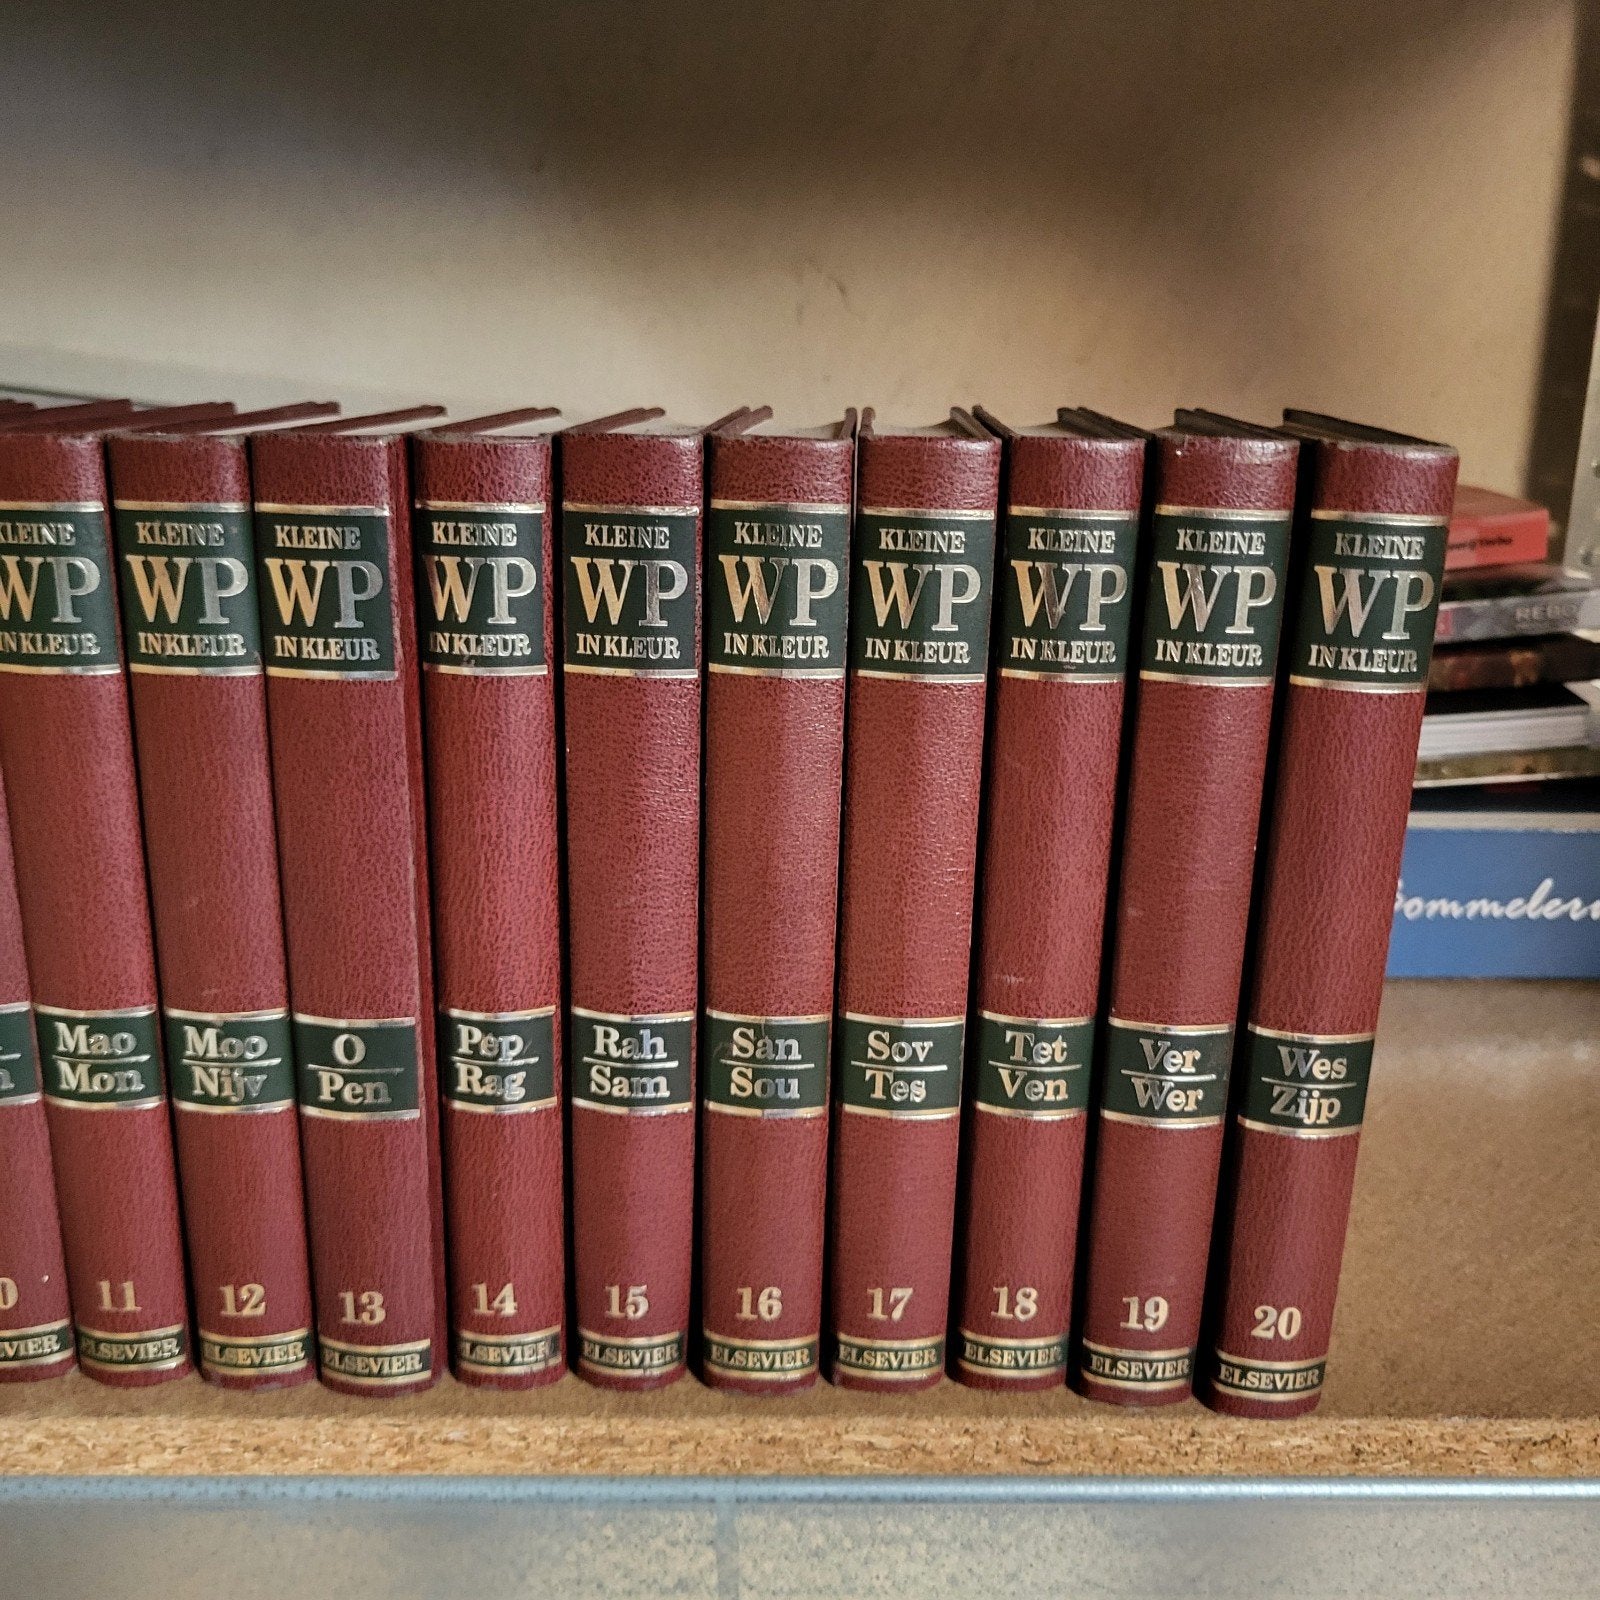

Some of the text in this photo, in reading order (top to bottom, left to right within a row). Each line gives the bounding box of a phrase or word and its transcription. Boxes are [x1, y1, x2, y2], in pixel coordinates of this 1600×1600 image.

[0, 521, 76, 545] LEINE
[136, 521, 226, 546] KLEINE
[274, 525, 361, 550] KLEINE
[432, 521, 518, 546] KLEINE
[584, 524, 670, 549] KLEINE
[734, 522, 823, 548] KLEINE
[879, 528, 965, 553] KLEINE
[1028, 527, 1116, 553] KLEINE
[1176, 528, 1266, 555] KLEINE
[1334, 533, 1426, 558] KLEINE
[0, 555, 100, 623] WP
[126, 555, 249, 624] WP
[264, 557, 384, 628] WP
[422, 556, 537, 624] WP
[571, 556, 689, 627] WP
[718, 555, 839, 626] WP
[863, 560, 981, 631] WP
[1010, 560, 1127, 631] WP
[1157, 560, 1277, 634] WP
[1313, 566, 1435, 640] WP
[0, 632, 101, 655] N KLEUR
[139, 632, 247, 656] IN KLEUR
[274, 635, 380, 660] IN KLEUR
[430, 632, 531, 656] IN KLEUR
[576, 633, 680, 659] IN KLEUR
[724, 632, 830, 659] IN KLEUR
[865, 637, 970, 663] IN KLEUR
[1011, 637, 1117, 663] IN KLEUR
[1155, 639, 1263, 666] IN KLEUR
[1309, 646, 1418, 672] IN KLEUR
[1395, 877, 1600, 921] ommeler
[55, 1022, 136, 1056] Mao
[184, 1025, 268, 1060] Moo
[332, 1033, 366, 1065] O
[457, 1024, 524, 1063] Pep
[593, 1025, 667, 1060] Rah
[731, 1027, 801, 1060] San
[868, 1030, 933, 1063] Sov
[1006, 1031, 1068, 1065] Tet
[1139, 1038, 1200, 1073] Ver
[57, 1061, 144, 1095] Mon
[1278, 1046, 1347, 1079] Wes
[192, 1066, 267, 1102] Nijv
[318, 1071, 390, 1105] Pen
[456, 1063, 525, 1102] Rag
[589, 1064, 670, 1098] Sam
[730, 1066, 800, 1099] Sou
[865, 1069, 926, 1102] Tes
[999, 1068, 1068, 1101] Ven
[1131, 1077, 1203, 1112] Wer
[1270, 1086, 1340, 1124] Zijp
[98, 1280, 142, 1312] 11
[220, 1284, 266, 1317] 12
[338, 1291, 387, 1326] 13
[472, 1282, 517, 1316] 14
[605, 1284, 649, 1319] 15
[736, 1286, 782, 1321] 16
[866, 1287, 913, 1321] 17
[991, 1287, 1038, 1322] 18
[1119, 1296, 1168, 1331] 19
[1250, 1305, 1301, 1340] 20
[0, 1334, 60, 1357] VIER
[80, 1338, 180, 1361] ELSEVIER
[202, 1342, 305, 1365] ELSEVIER
[323, 1349, 422, 1374] ELSEVIER
[460, 1339, 550, 1364] LSEVIER
[583, 1344, 678, 1366] ELSEVIER
[711, 1347, 809, 1369] ELSEVIER
[838, 1343, 936, 1368] ELSEVIER
[965, 1341, 1060, 1366] ELSEVIER
[1091, 1358, 1189, 1379] ELSEVIER
[1219, 1364, 1319, 1390] ELSEVIER
